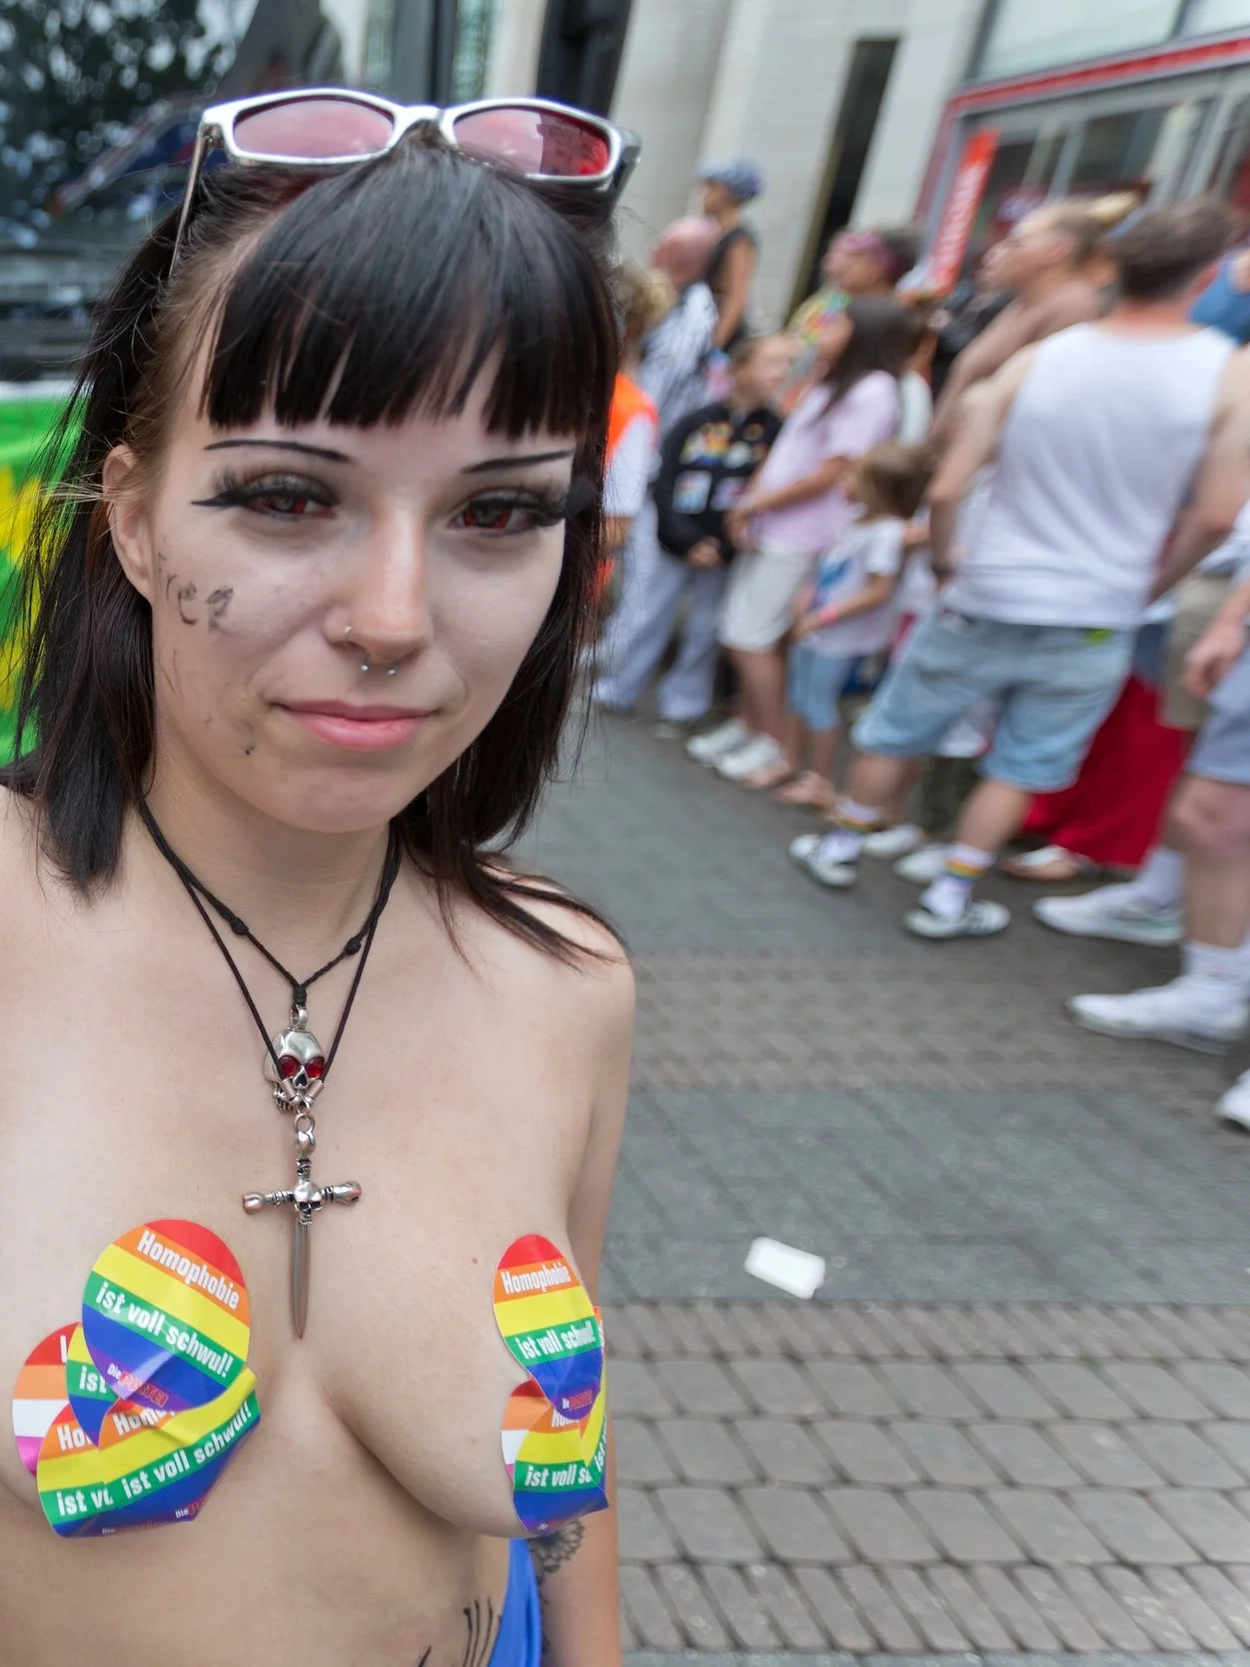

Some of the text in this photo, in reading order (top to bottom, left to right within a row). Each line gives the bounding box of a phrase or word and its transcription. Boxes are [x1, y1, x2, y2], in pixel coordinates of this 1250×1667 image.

[137, 1230, 240, 1309] Homophobie
[95, 1281, 234, 1378] ist voll schwul!
[515, 1336, 542, 1360] ist
[121, 1400, 252, 1499] ist voll schwul!
[525, 1465, 549, 1488] ist
[552, 1463, 577, 1487] voll
[56, 1491, 87, 1516] ist
